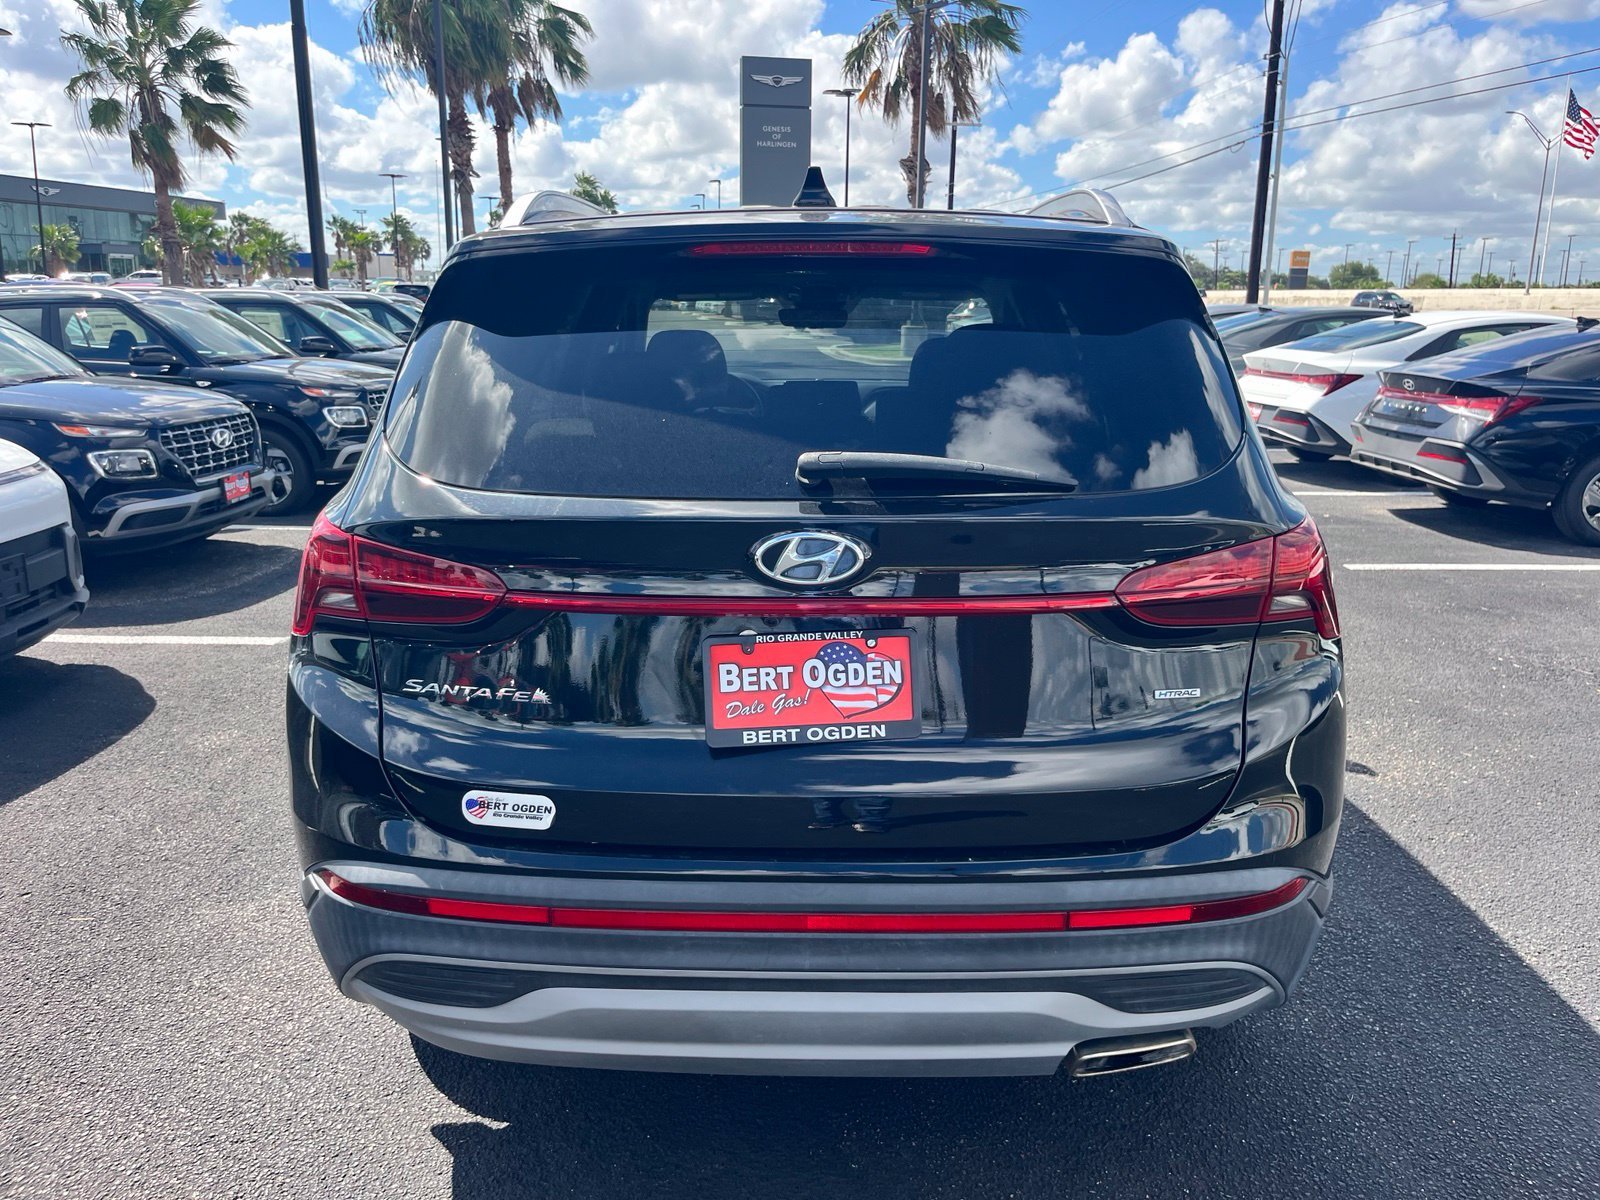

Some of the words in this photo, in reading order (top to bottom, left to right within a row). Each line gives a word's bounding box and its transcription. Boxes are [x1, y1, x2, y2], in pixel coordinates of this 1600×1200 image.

[762, 125, 791, 133] GENESIS
[756, 140, 797, 148] HARLINGEN
[756, 633, 775, 643] RIO
[777, 632, 822, 643] GRANDE
[823, 630, 864, 641] VALLEY
[718, 663, 794, 693] BERT
[802, 658, 902, 689] OGDEN
[1158, 689, 1198, 698] HTRAC
[725, 700, 766, 719] Dale
[771, 688, 811, 715] Gas!
[742, 728, 801, 744] BERT
[806, 724, 886, 741] OGDEN
[478, 800, 509, 811] BERT
[512, 803, 552, 814] OGDEN
